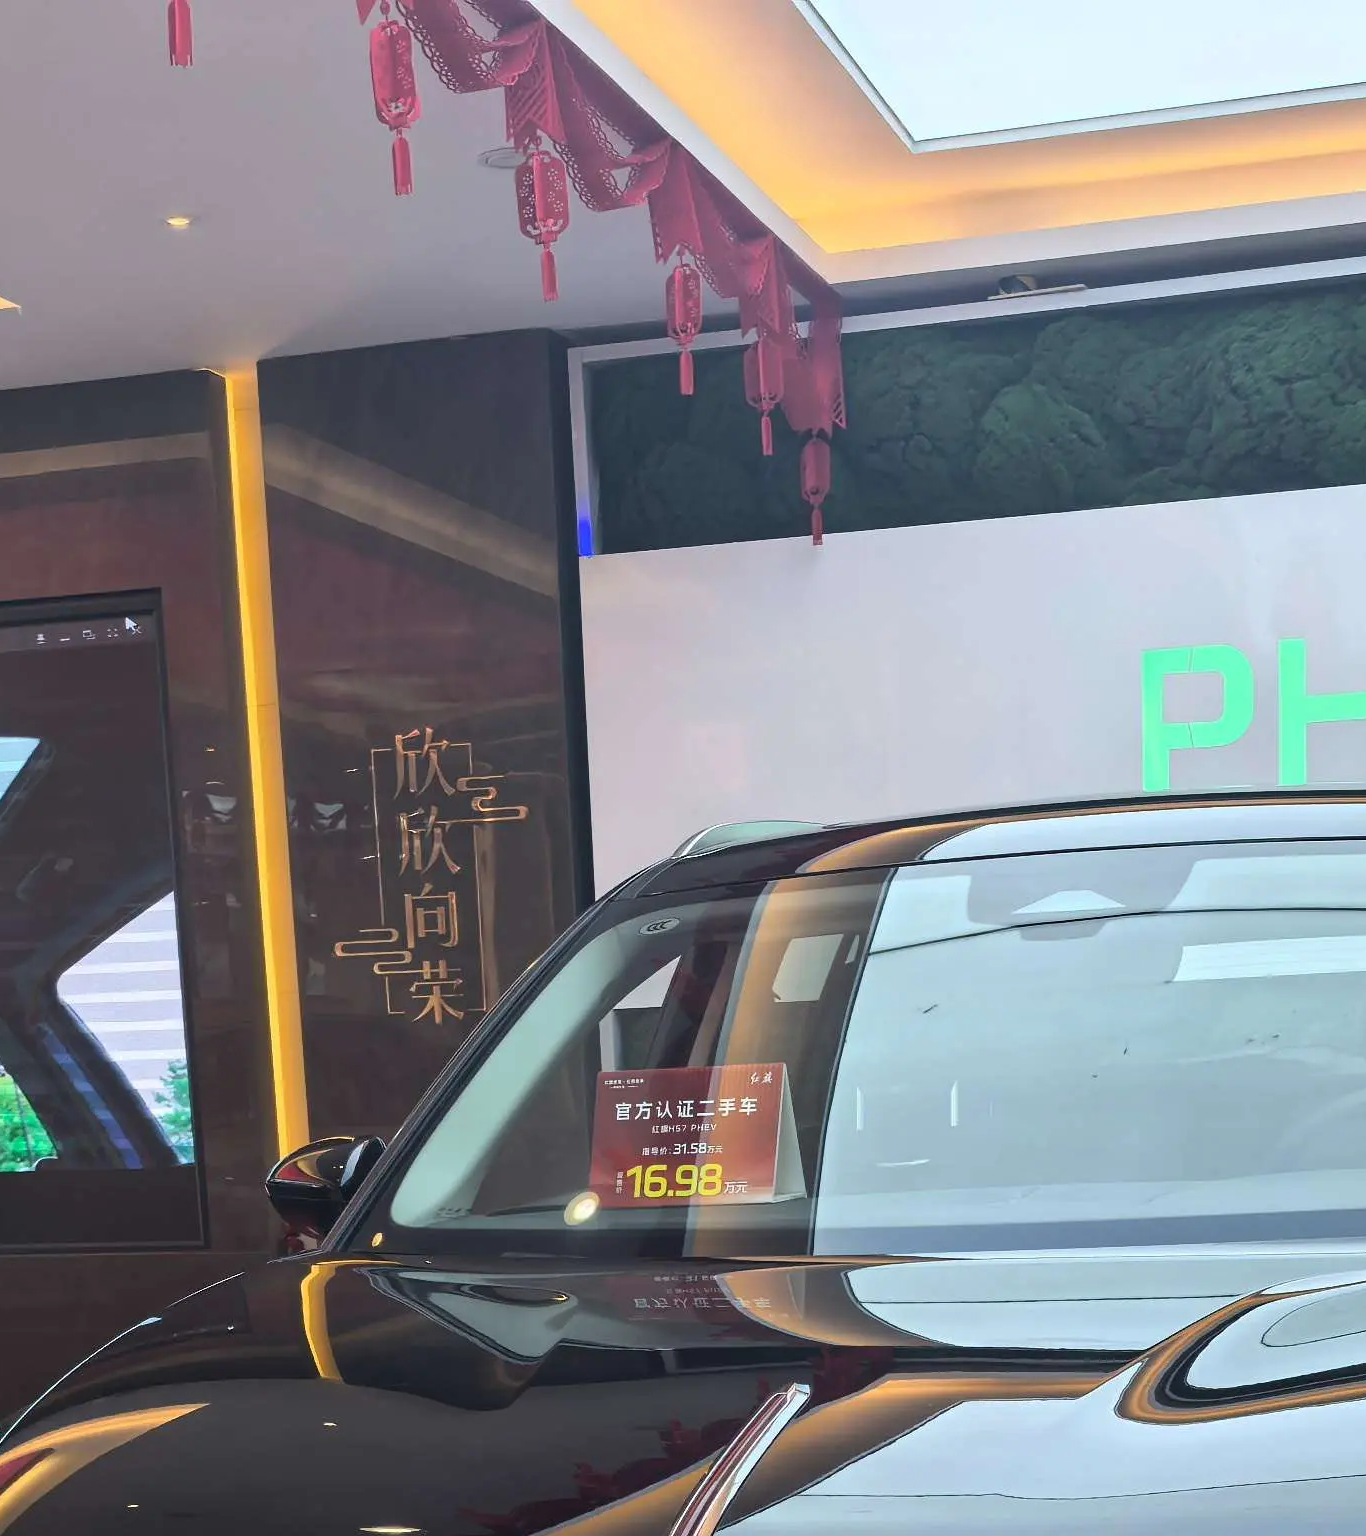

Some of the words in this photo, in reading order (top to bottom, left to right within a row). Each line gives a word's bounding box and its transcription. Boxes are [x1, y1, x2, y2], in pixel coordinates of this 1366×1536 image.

[393, 727, 464, 1025] 欣欣向荣
[615, 1097, 758, 1121] 官方认证二手车
